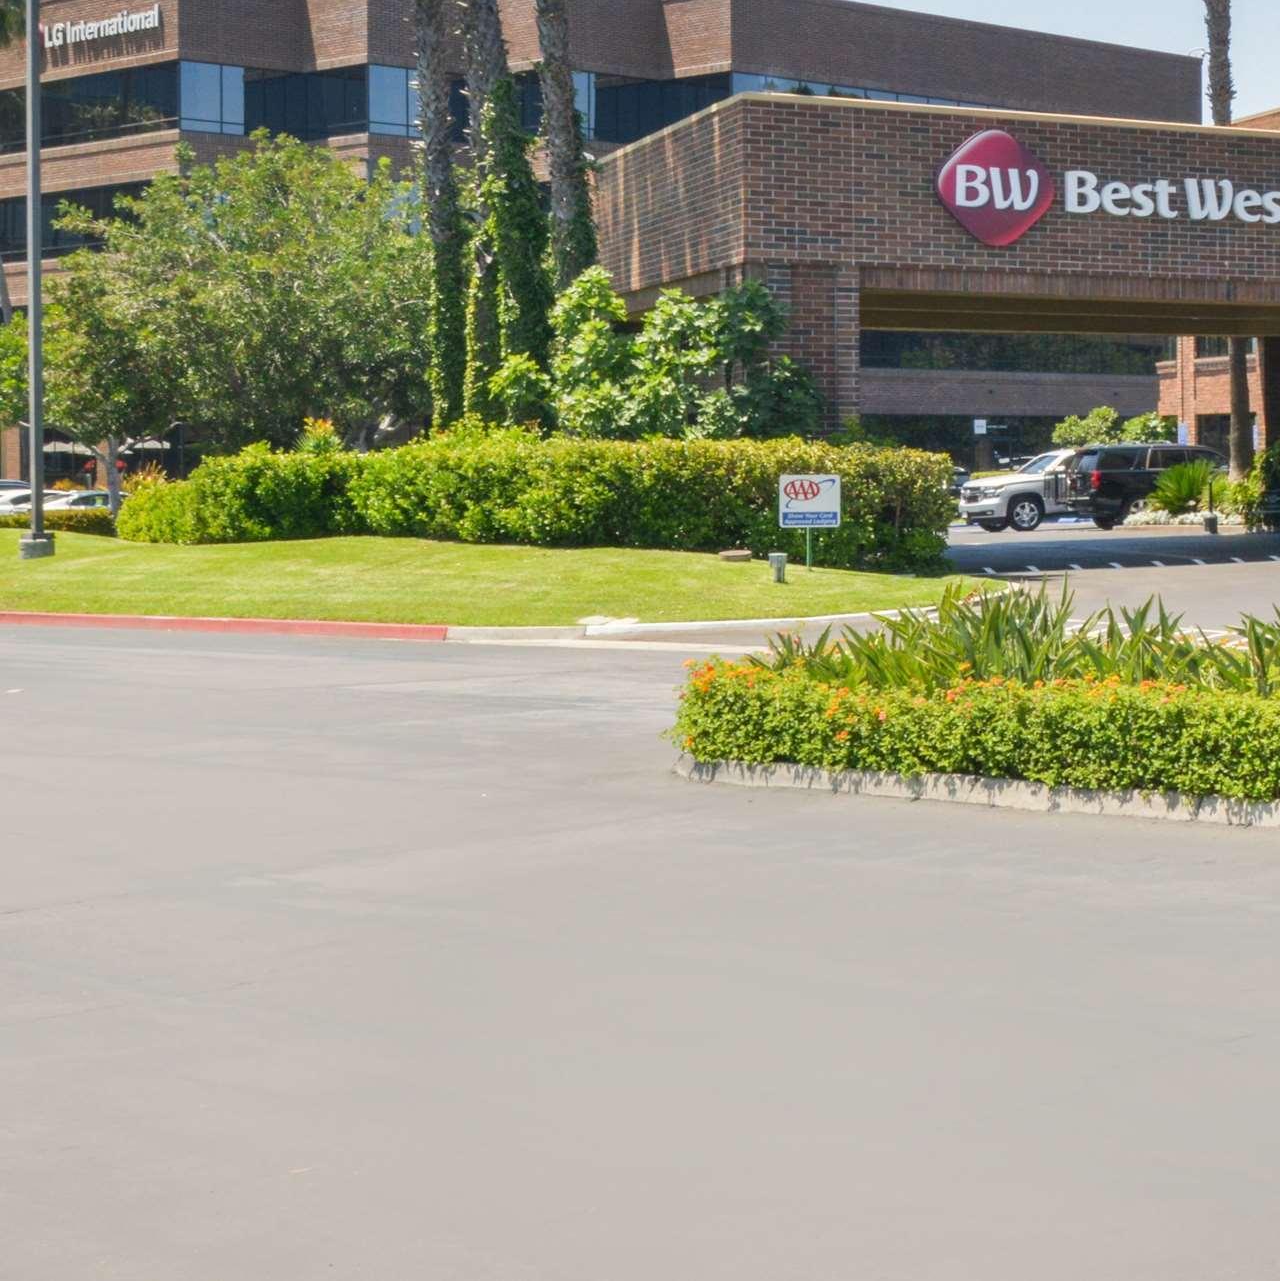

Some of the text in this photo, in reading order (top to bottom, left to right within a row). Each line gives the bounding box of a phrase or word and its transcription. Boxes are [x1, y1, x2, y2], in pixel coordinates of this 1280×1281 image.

[44, 3, 160, 48] LG International
[955, 164, 1039, 210] BW
[1064, 170, 1178, 218] Best
[785, 480, 818, 500] AAA
